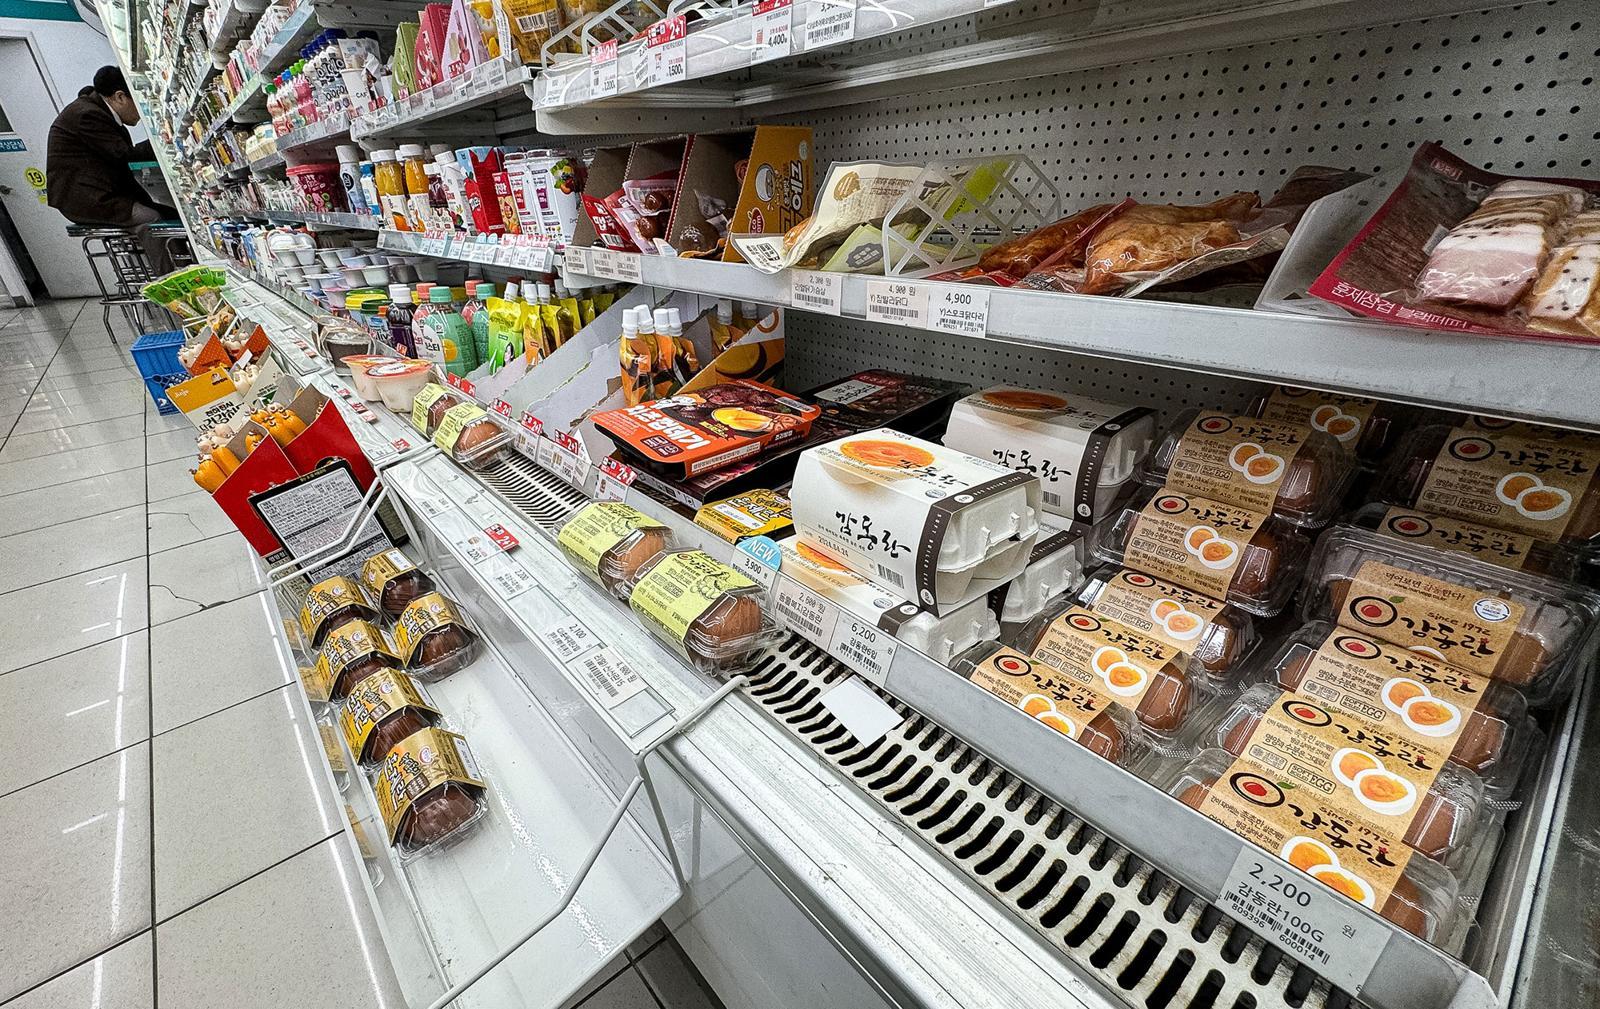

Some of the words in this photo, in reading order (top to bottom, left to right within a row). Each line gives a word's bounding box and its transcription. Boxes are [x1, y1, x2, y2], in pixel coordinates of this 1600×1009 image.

[28, 171, 42, 183] 19
[945, 292, 971, 305] 4,900
[1190, 507, 1254, 532] 감동란
[835, 510, 912, 559] 감동란
[750, 539, 777, 563] NEW
[744, 558, 762, 574] 3,900
[568, 624, 587, 639] 2,100
[851, 622, 876, 643] 6,200
[1400, 616, 1495, 659] 감동란
[1462, 621, 1492, 637] 1972
[1102, 629, 1165, 661] 감동란
[1384, 655, 1478, 695] 감동란
[1031, 673, 1097, 712] 감동란
[1360, 704, 1383, 720] EGG
[1335, 723, 1434, 772] 감동란
[1397, 740, 1426, 755] 1972
[1292, 764, 1312, 778] SOFT
[1309, 774, 1333, 792] EGG
[1288, 803, 1396, 868] 감동란
[1358, 825, 1390, 846] 1972
[1248, 861, 1312, 908] 2,200
[1237, 881, 1326, 944] 감동란100G
[1231, 902, 1266, 929] 809396
[1278, 933, 1316, 962] 600014
[1341, 923, 1356, 939] 원
